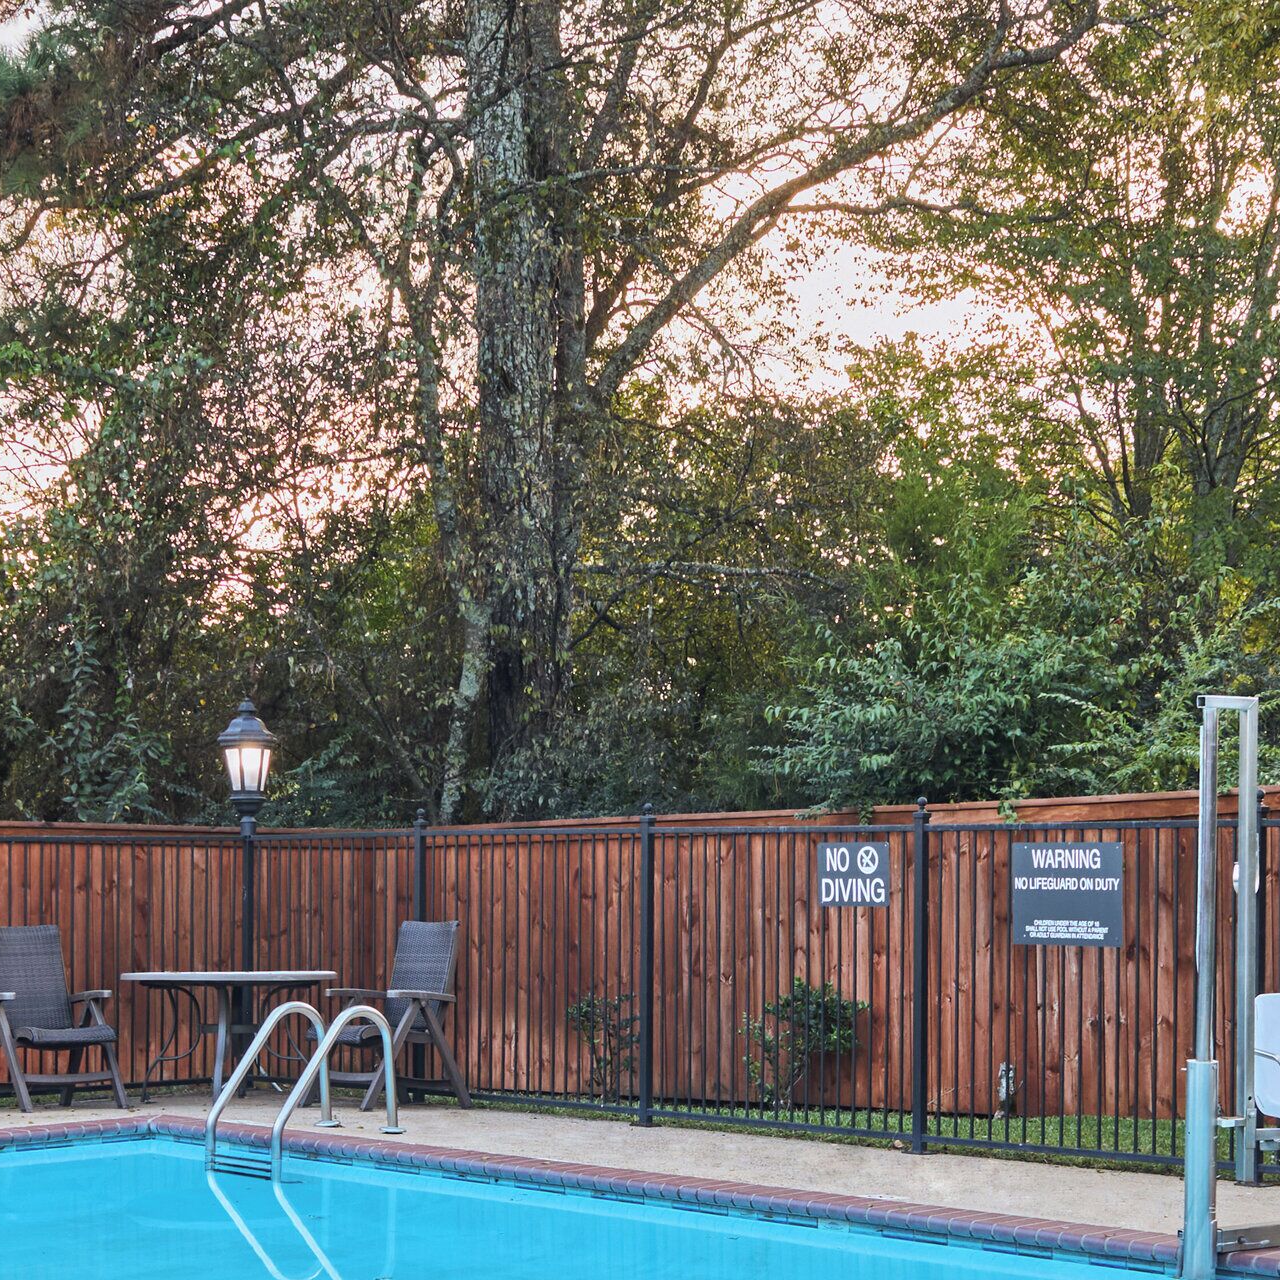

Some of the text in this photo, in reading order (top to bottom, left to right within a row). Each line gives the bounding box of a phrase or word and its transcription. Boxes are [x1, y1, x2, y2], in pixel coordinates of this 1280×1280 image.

[826, 847, 849, 872] NO
[1032, 849, 1100, 869] WARNING
[821, 878, 885, 903] DIVING
[1015, 877, 1119, 891] NO LIFEGUARD ON DUTY
